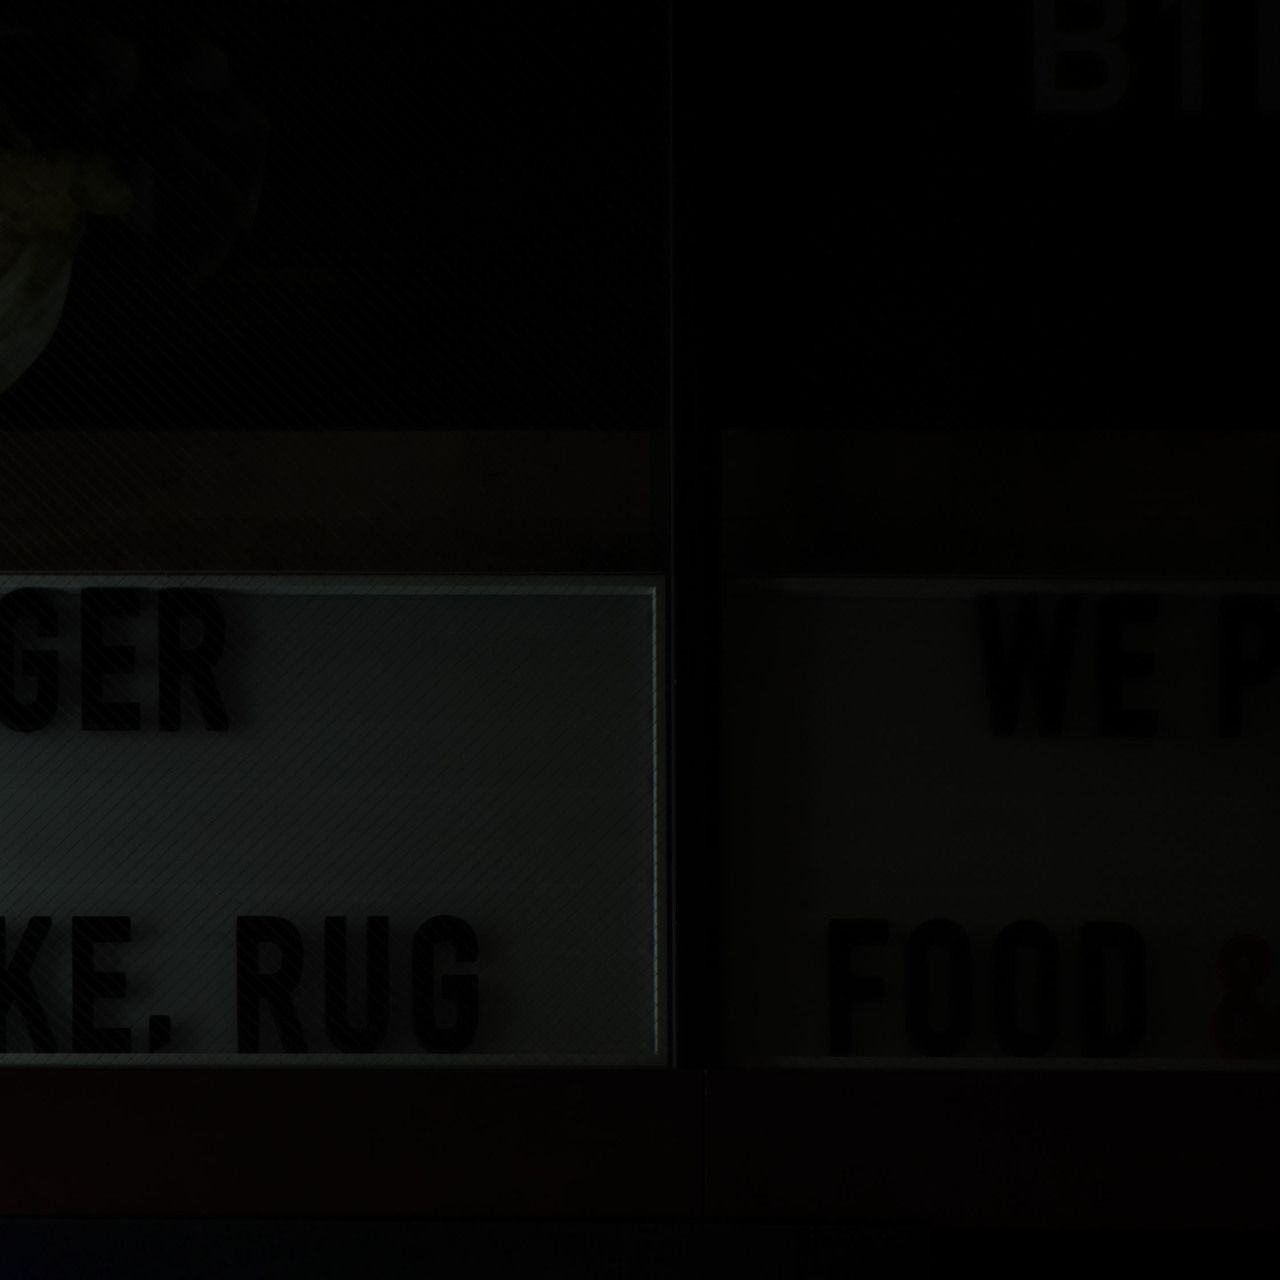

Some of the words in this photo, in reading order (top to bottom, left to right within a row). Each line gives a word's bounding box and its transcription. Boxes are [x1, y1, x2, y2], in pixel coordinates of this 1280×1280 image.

[975, 592, 1158, 738] WE
[236, 914, 482, 1053] RUG
[829, 917, 1147, 1058] FOOD
